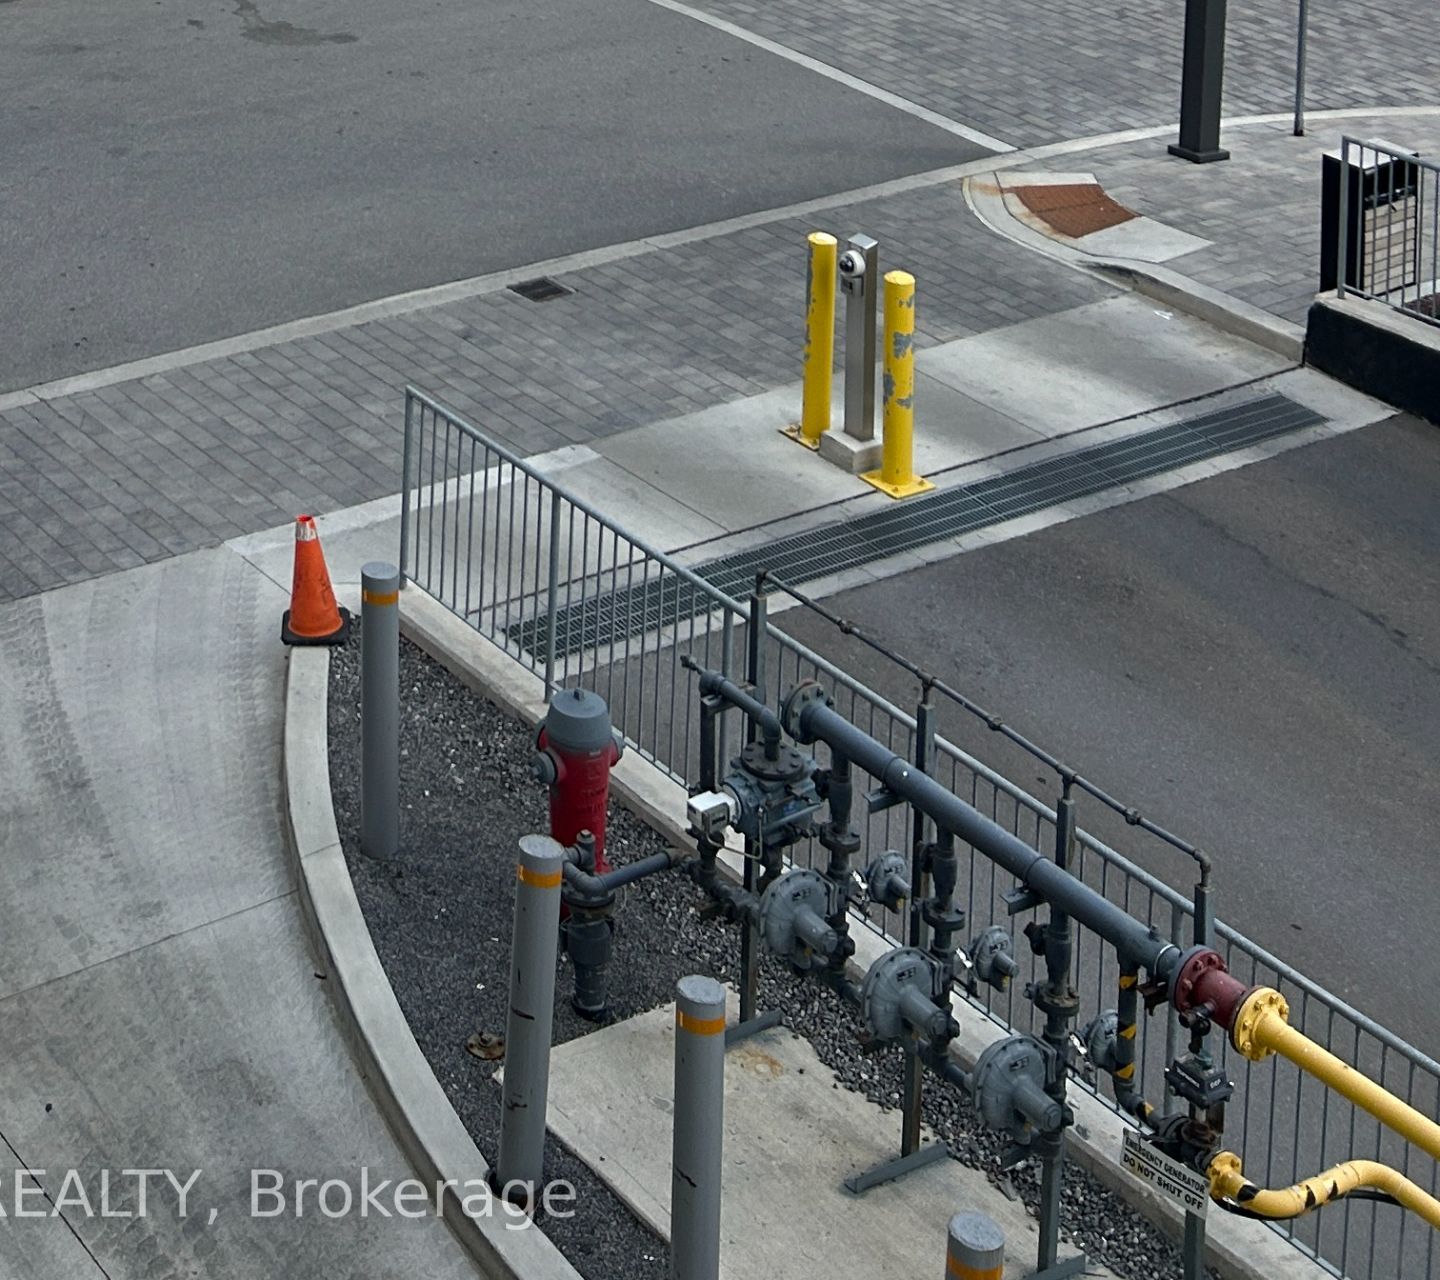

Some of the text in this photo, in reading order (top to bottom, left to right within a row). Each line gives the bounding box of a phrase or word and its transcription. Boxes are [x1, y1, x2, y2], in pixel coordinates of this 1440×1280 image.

[1123, 1153, 1203, 1210] DO NOT SHUT OFF
[1163, 1162, 1205, 1194] GENERATOR
